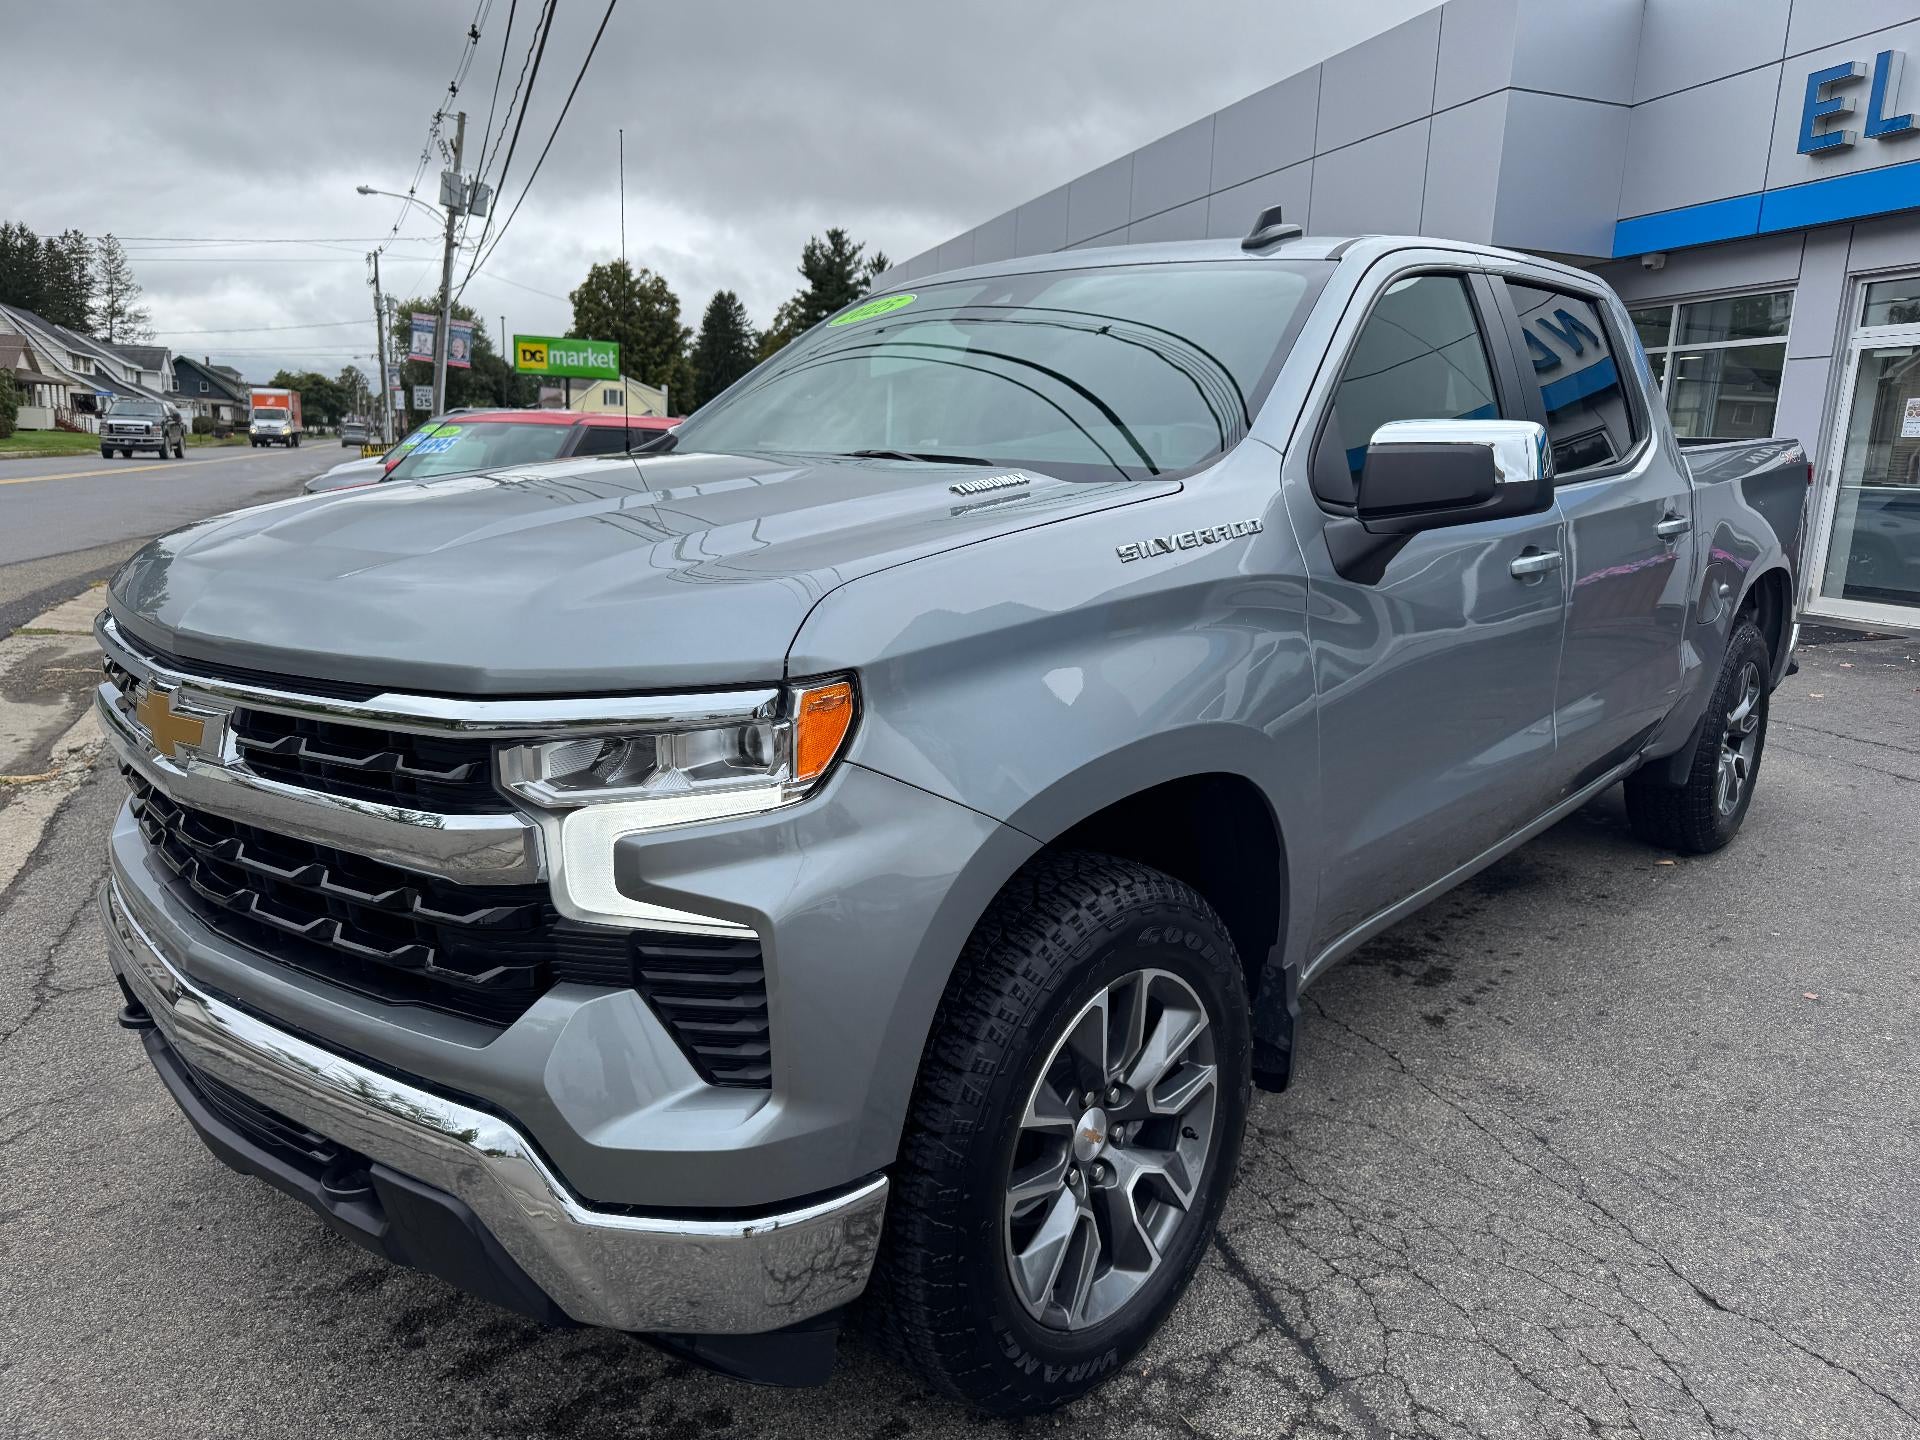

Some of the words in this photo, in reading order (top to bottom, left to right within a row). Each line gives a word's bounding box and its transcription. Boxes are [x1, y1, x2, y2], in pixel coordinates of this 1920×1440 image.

[521, 348, 545, 362] DG
[549, 347, 616, 369] market
[416, 398, 432, 407] 35
[949, 472, 1031, 496] TURBOMAX
[1116, 518, 1264, 563] SILVERADO
